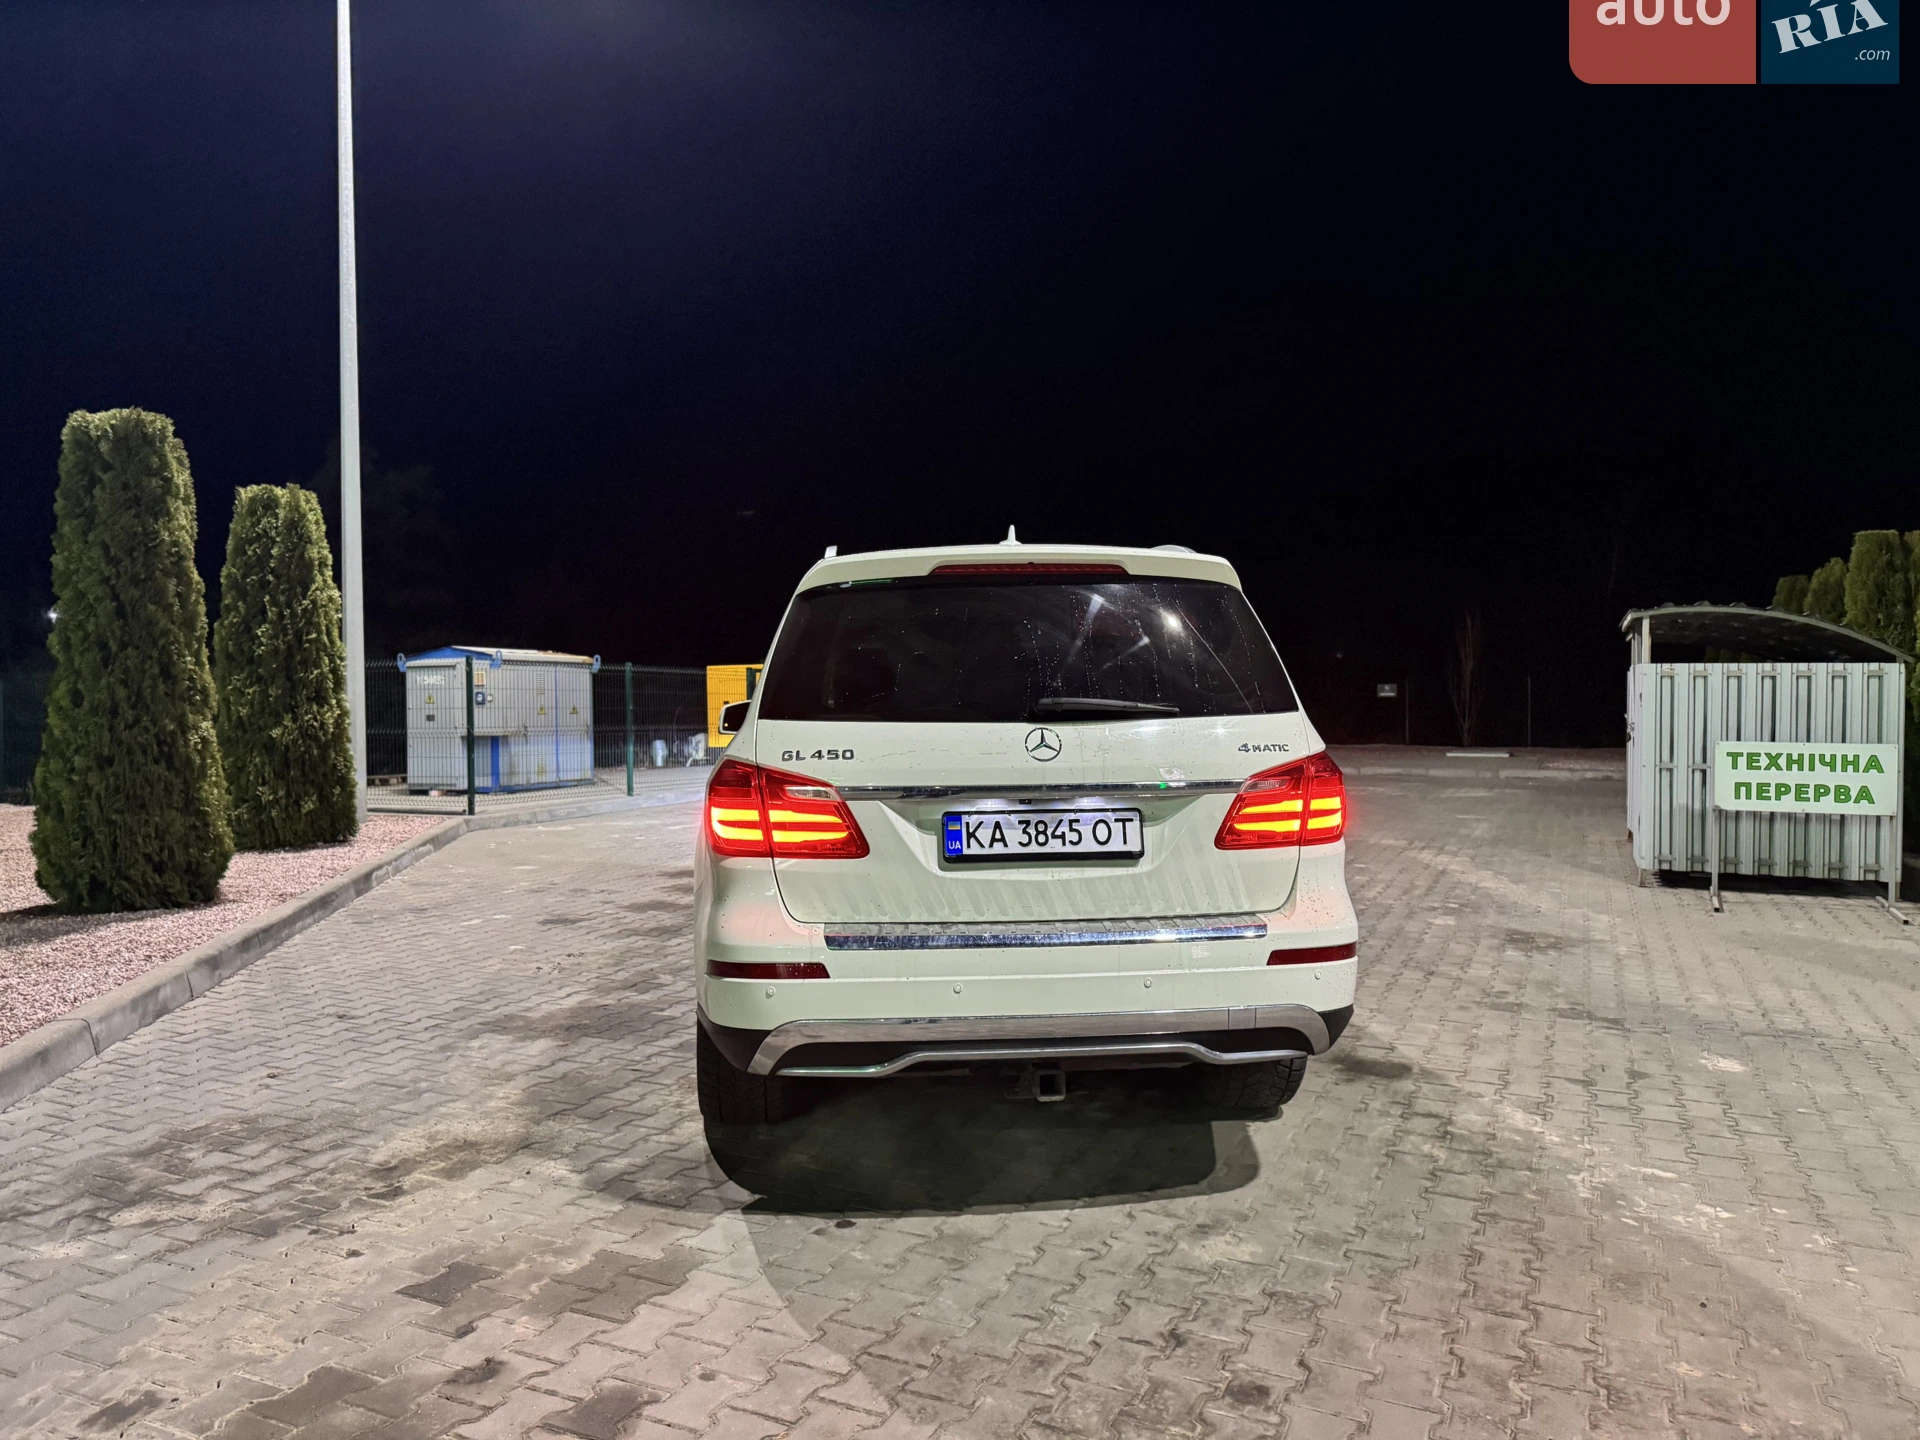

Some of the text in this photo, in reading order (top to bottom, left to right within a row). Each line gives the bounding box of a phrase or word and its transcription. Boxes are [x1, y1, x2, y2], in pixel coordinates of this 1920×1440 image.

[781, 749, 855, 762] GL 450
[1726, 752, 1885, 774] ТЕХНІЧНА
[1734, 782, 1876, 804] ПЕРЕРВА
[965, 817, 1134, 849] KA 3845 OT
[948, 840, 962, 850] UA
